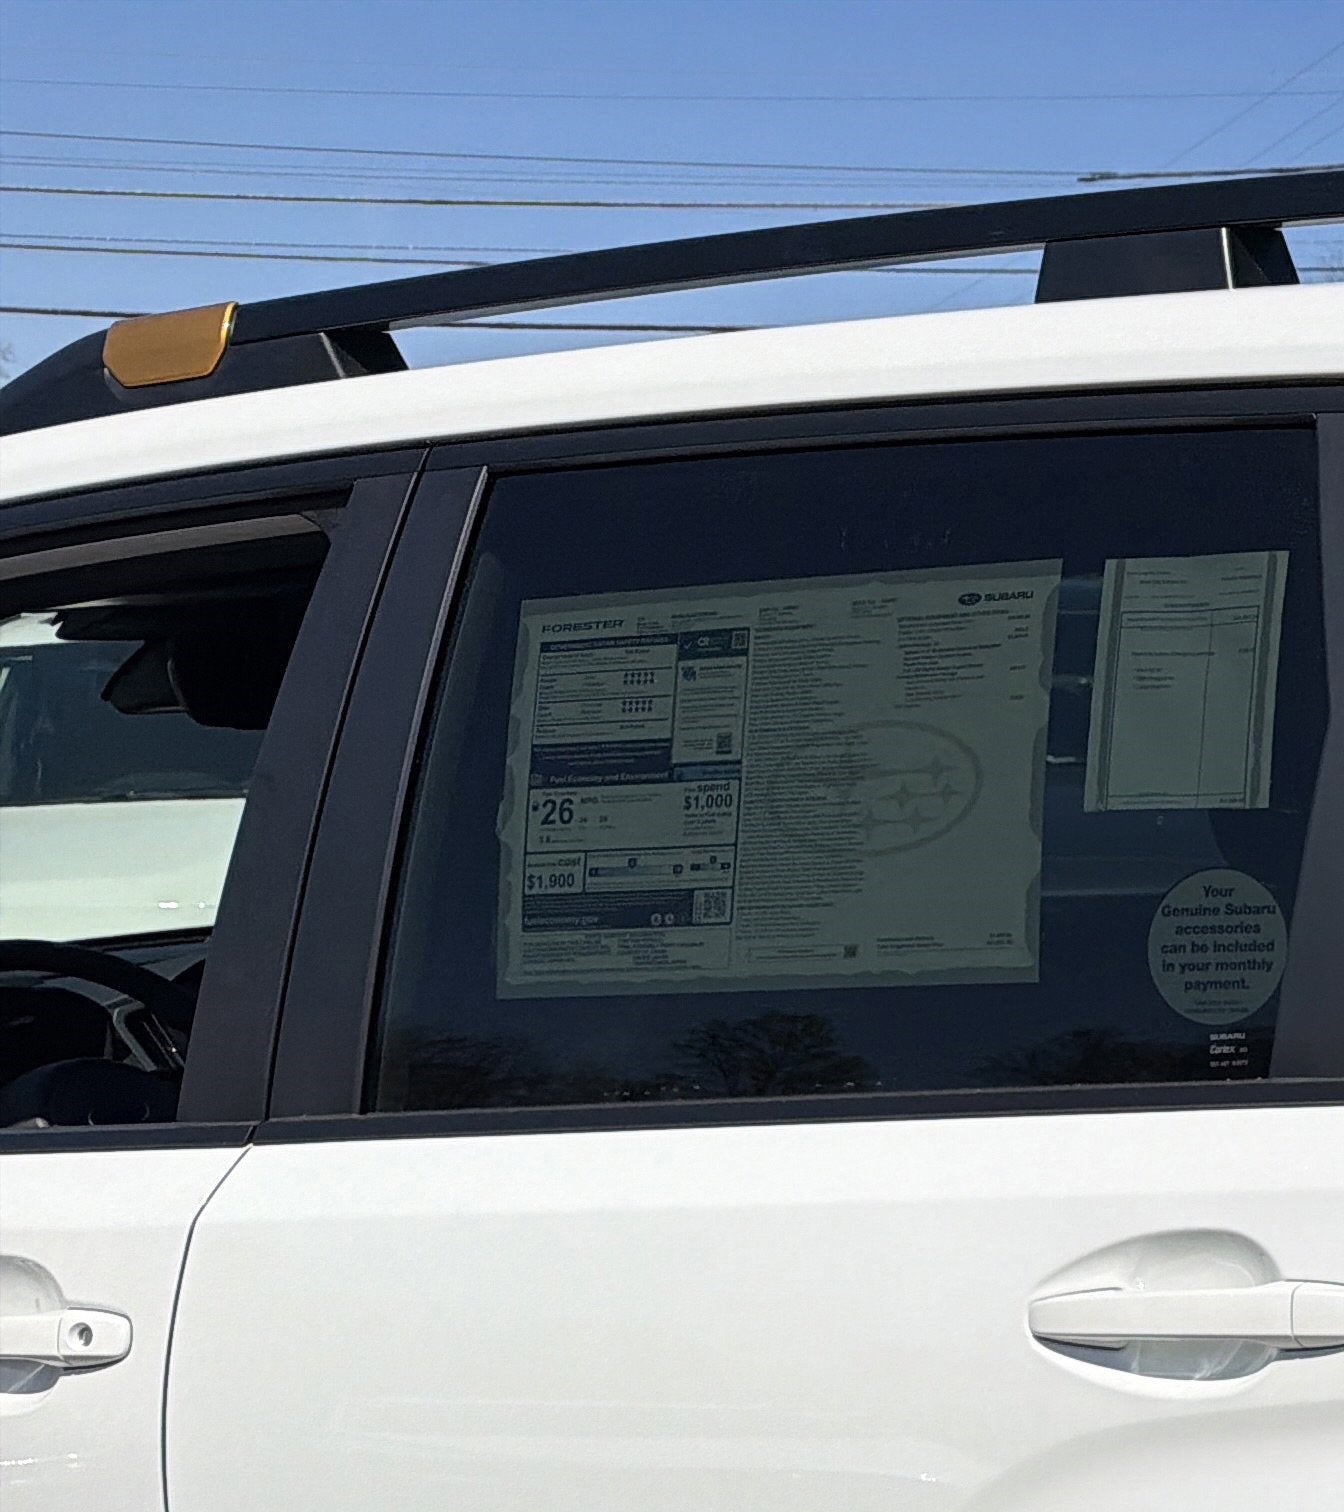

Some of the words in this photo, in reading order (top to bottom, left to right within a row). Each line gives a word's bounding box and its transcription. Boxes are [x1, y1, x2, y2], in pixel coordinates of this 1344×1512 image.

[984, 591, 1034, 601] SUBARU
[541, 619, 624, 633] FORESTER
[697, 782, 730, 794] spend
[683, 794, 733, 811] $1,000
[541, 798, 574, 825] 26
[558, 856, 581, 866] cost
[527, 873, 575, 890] $1,900
[1202, 886, 1235, 898] Your
[1161, 904, 1220, 917] Genuine
[1224, 903, 1276, 915] Subaru
[1175, 922, 1261, 935] accessories
[1161, 944, 1186, 954] can
[1191, 941, 1209, 953] be
[1213, 940, 1275, 953] included
[1162, 961, 1175, 972] in
[1179, 962, 1211, 975] your
[1215, 958, 1274, 972] monthly
[1184, 979, 1250, 993] payment.
